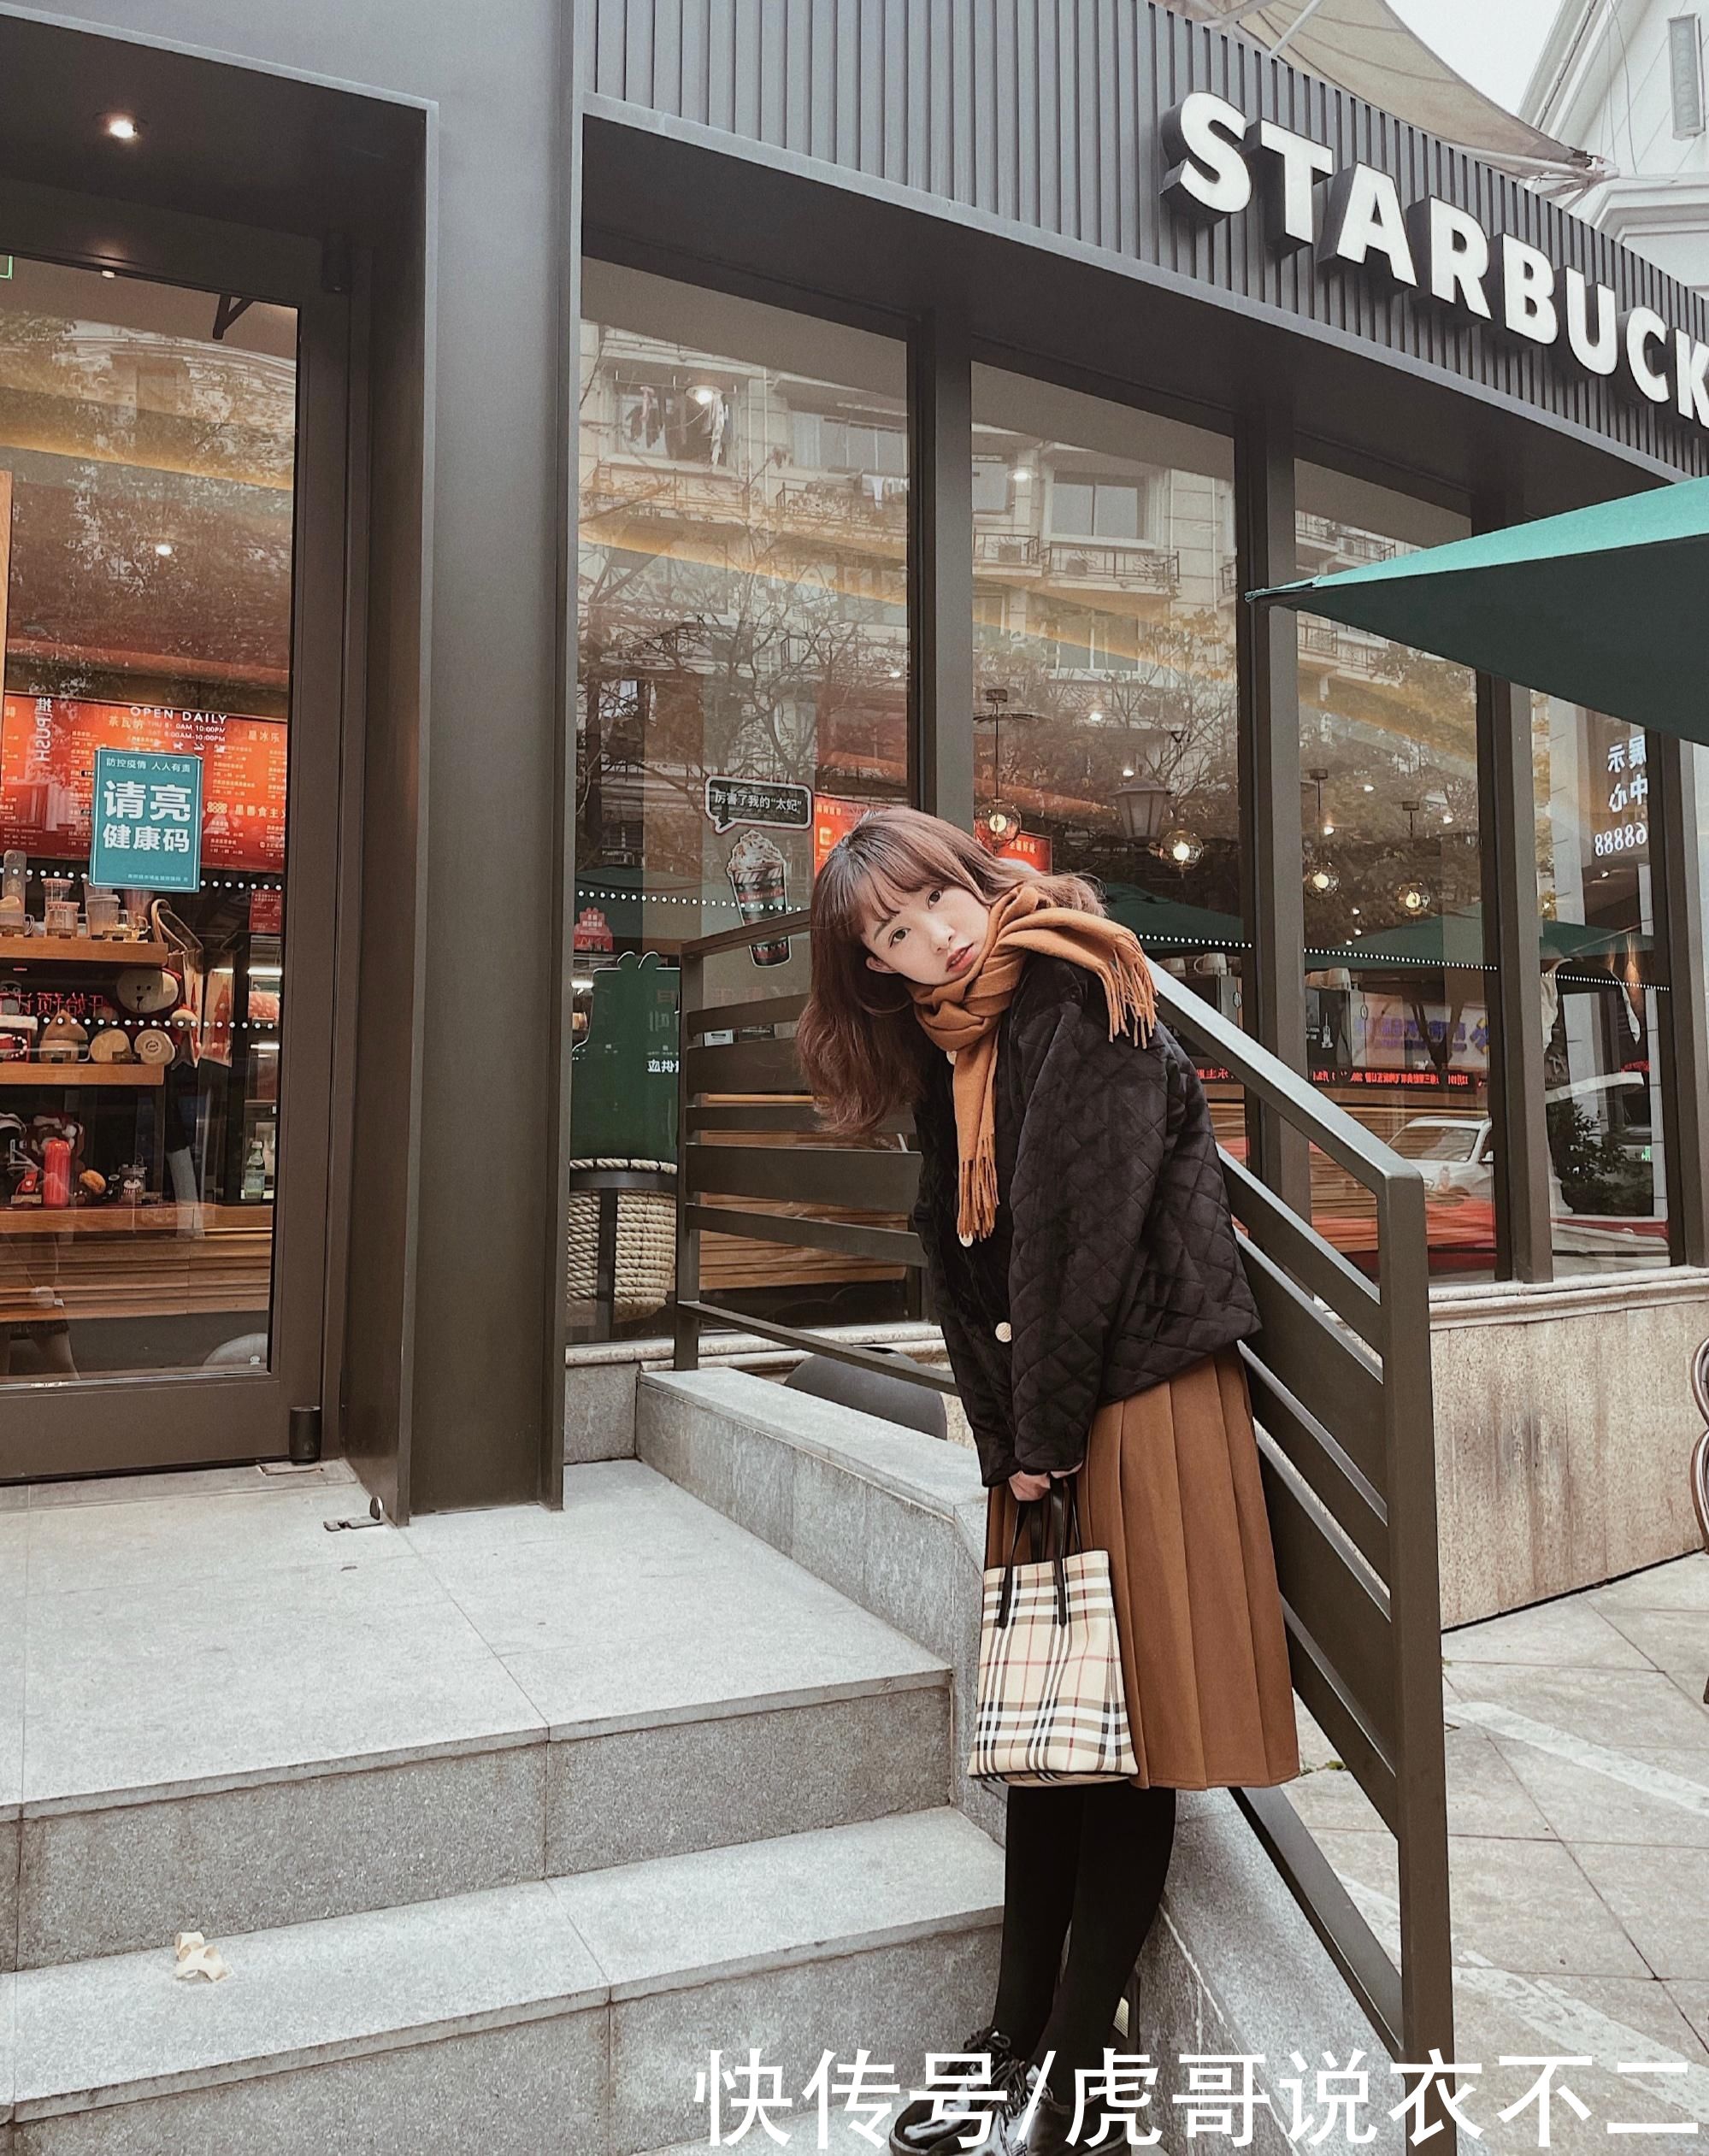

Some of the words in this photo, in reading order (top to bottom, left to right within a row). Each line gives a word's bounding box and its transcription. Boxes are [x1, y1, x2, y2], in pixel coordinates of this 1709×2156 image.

[130, 706, 174, 720] OPEN
[182, 711, 227, 725] DAILY
[106, 757, 146, 769] 防控疫情
[151, 761, 191, 773] 人人有责
[103, 779, 192, 822] 请亮
[103, 822, 191, 853] 健康码
